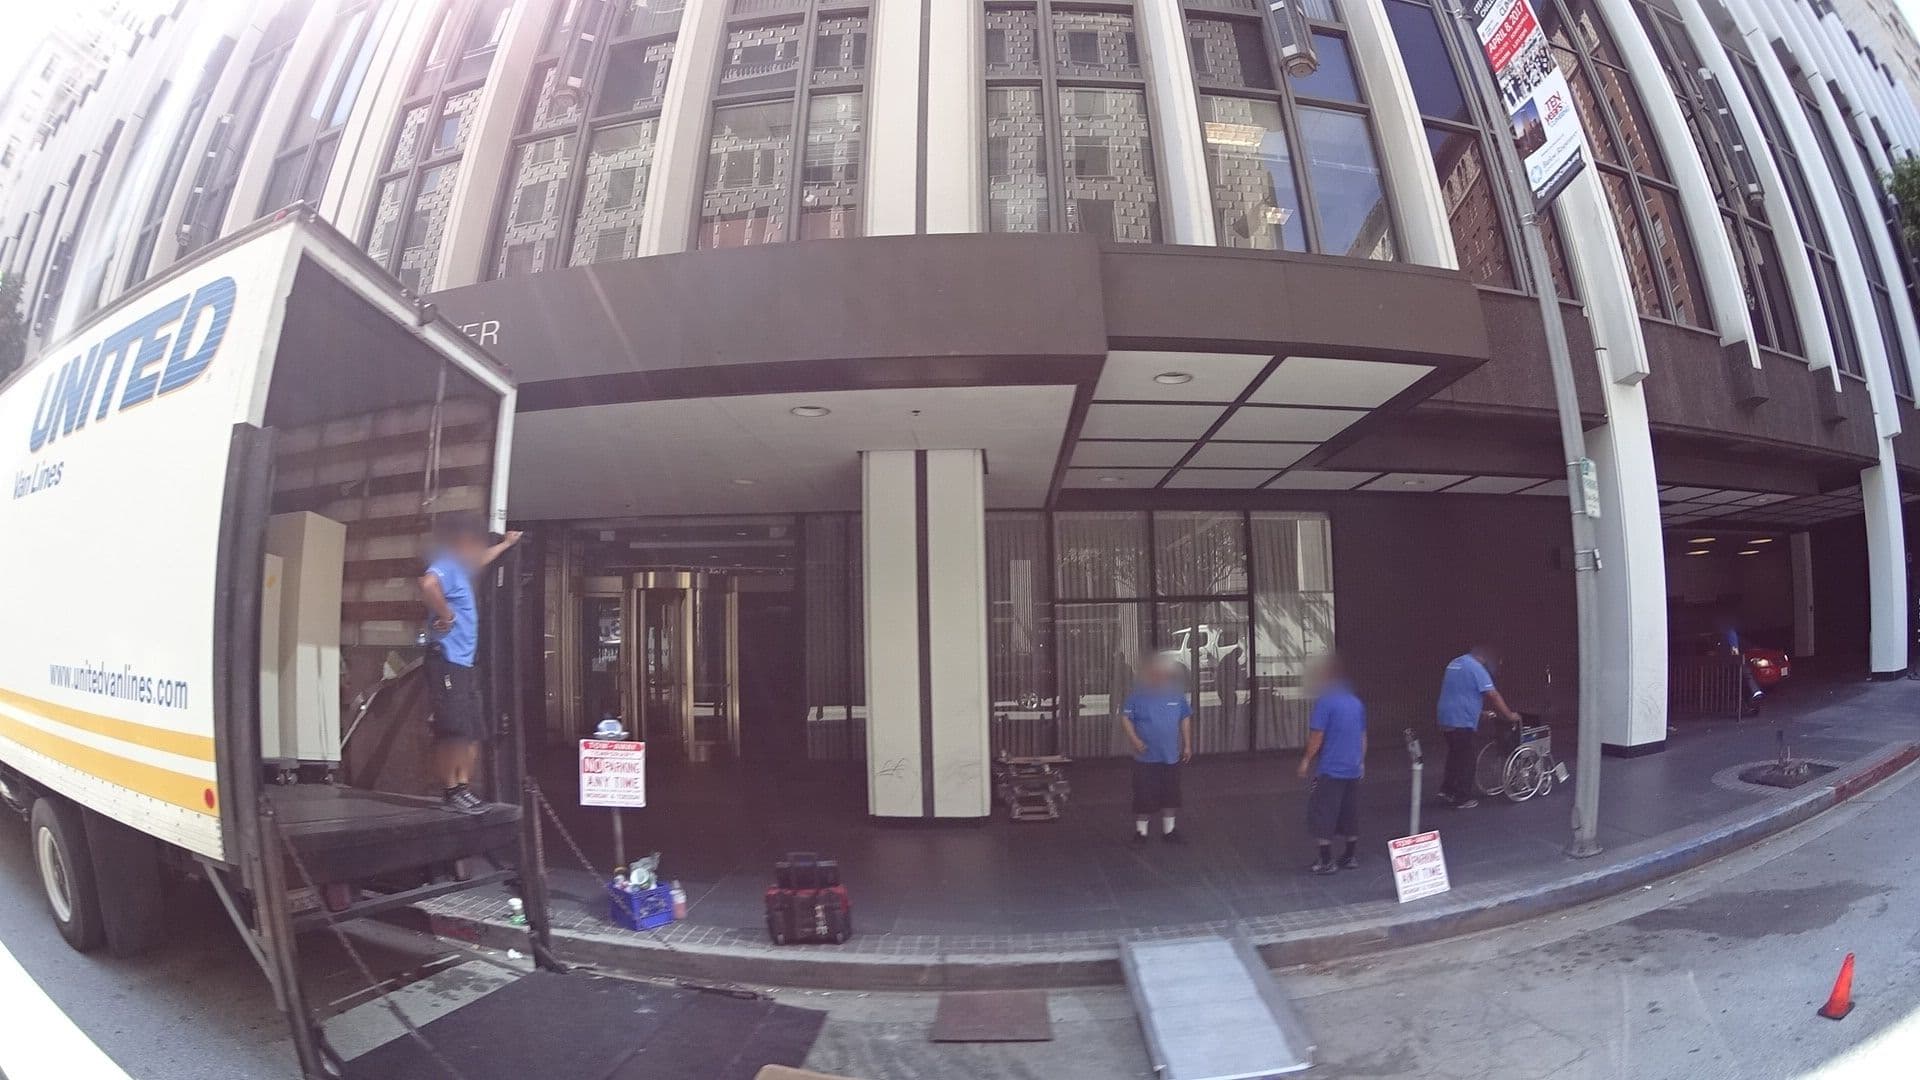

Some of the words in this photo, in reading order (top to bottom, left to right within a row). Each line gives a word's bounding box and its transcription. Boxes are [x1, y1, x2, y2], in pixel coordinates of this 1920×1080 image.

[1488, 28, 1508, 54] APRIL
[1510, 1, 1524, 26] 2017
[1544, 90, 1561, 111] TEN
[457, 320, 500, 346] ER
[29, 276, 237, 453] UNITED
[13, 470, 31, 500] Van
[31, 461, 64, 494] Lines
[50, 660, 187, 710] www.unitedvanlines.com
[585, 757, 602, 773] NO
[605, 761, 640, 774] PARKING
[586, 776, 609, 789] ANY
[612, 777, 640, 789] TIME
